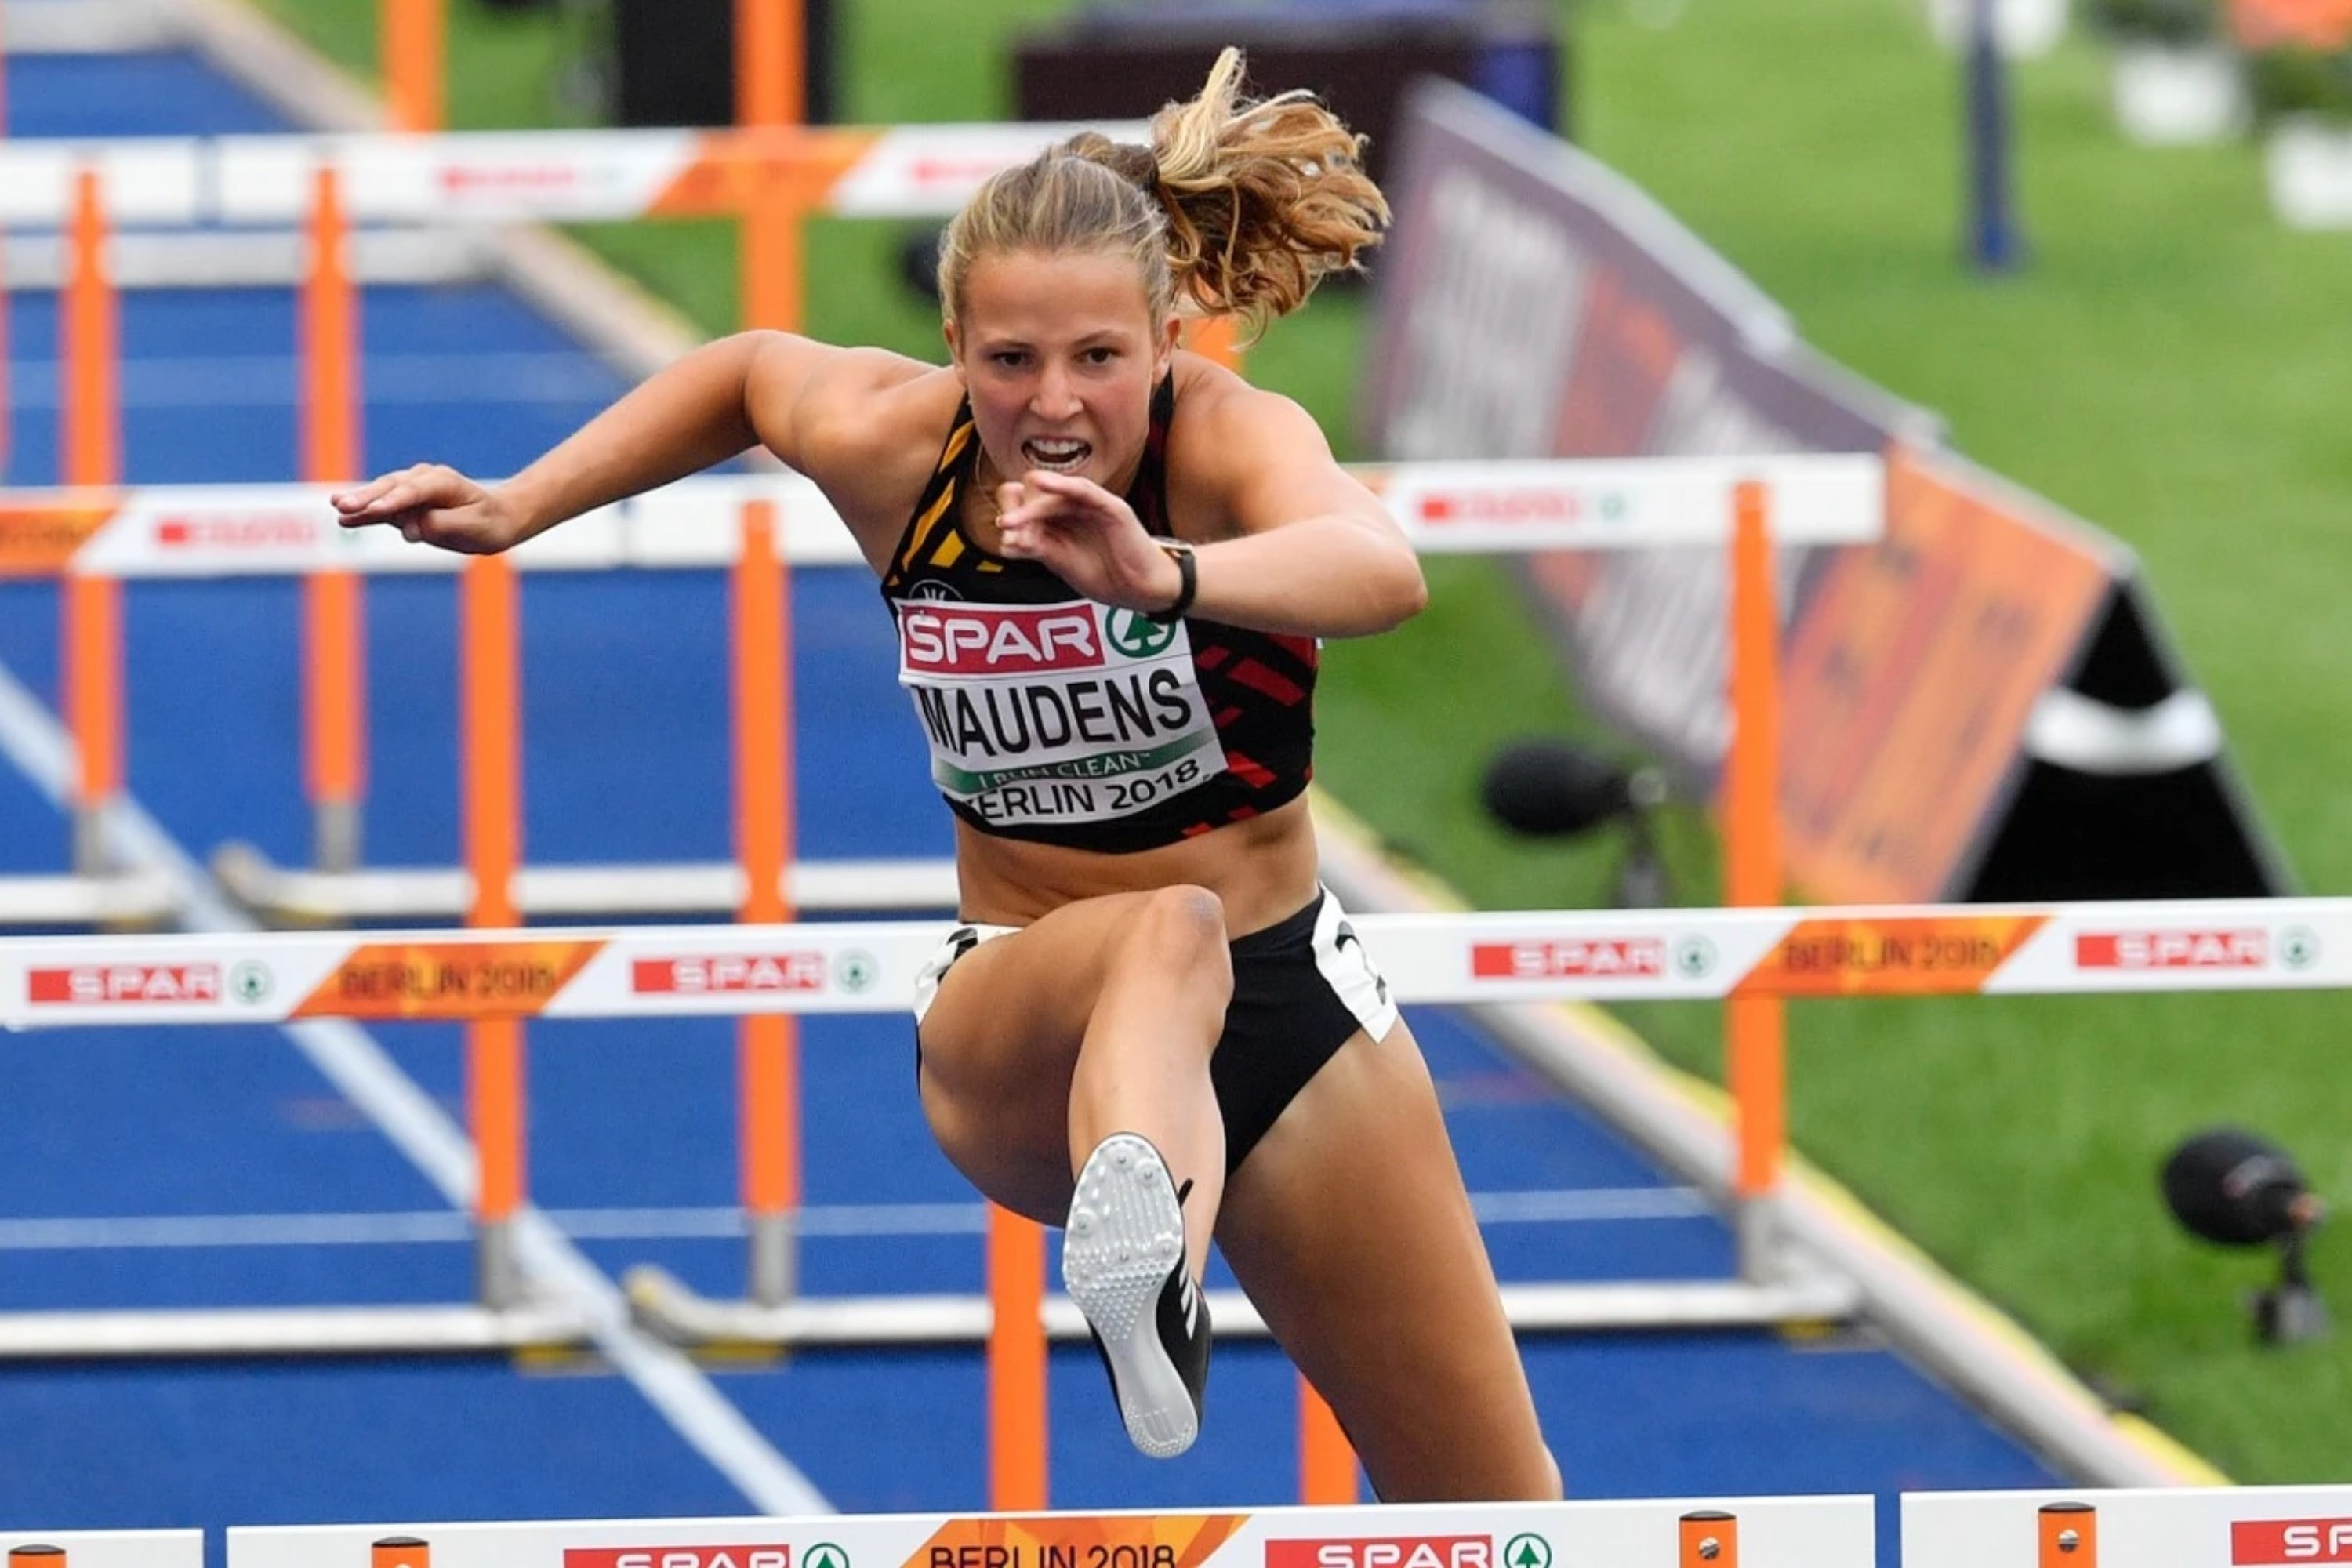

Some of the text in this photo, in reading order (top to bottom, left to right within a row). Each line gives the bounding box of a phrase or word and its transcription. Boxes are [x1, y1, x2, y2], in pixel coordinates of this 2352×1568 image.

[906, 614, 1095, 664] SPAR
[911, 669, 1192, 757] MAUDENS
[1058, 753, 1142, 779] CLEAN
[969, 758, 1200, 821] ERLIN 2018
[1512, 942, 1663, 977] SPAR
[2118, 931, 2267, 968] SPAR
[68, 966, 219, 1001] SPAR
[672, 956, 823, 991] SPAR
[931, 1544, 1174, 1568] BERLIN 2018
[1317, 1541, 1489, 1568] SPAR
